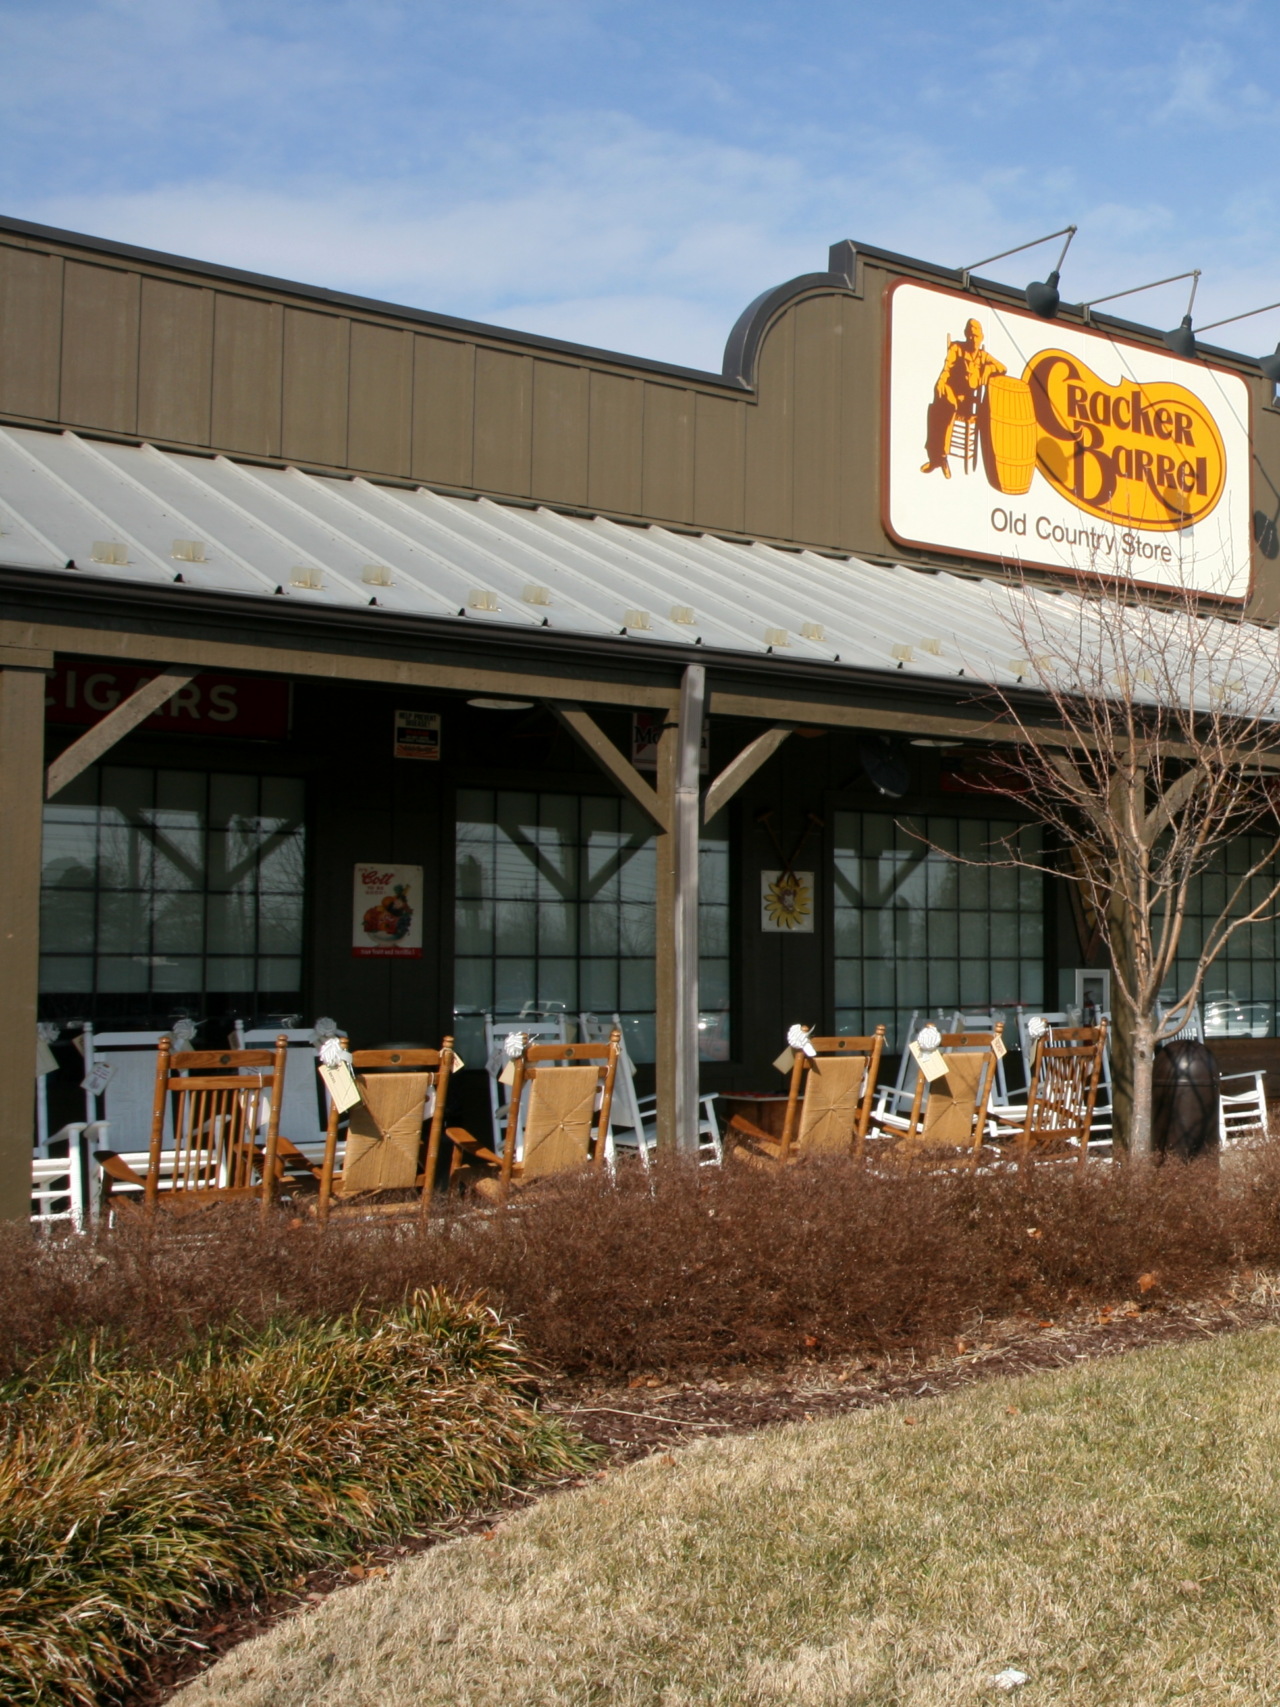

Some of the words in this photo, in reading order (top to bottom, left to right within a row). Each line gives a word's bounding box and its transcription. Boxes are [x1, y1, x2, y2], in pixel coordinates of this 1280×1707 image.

[991, 508, 1027, 536] Old
[1036, 516, 1115, 556] Country
[1122, 533, 1172, 563] Store
[361, 870, 395, 885] Cott
